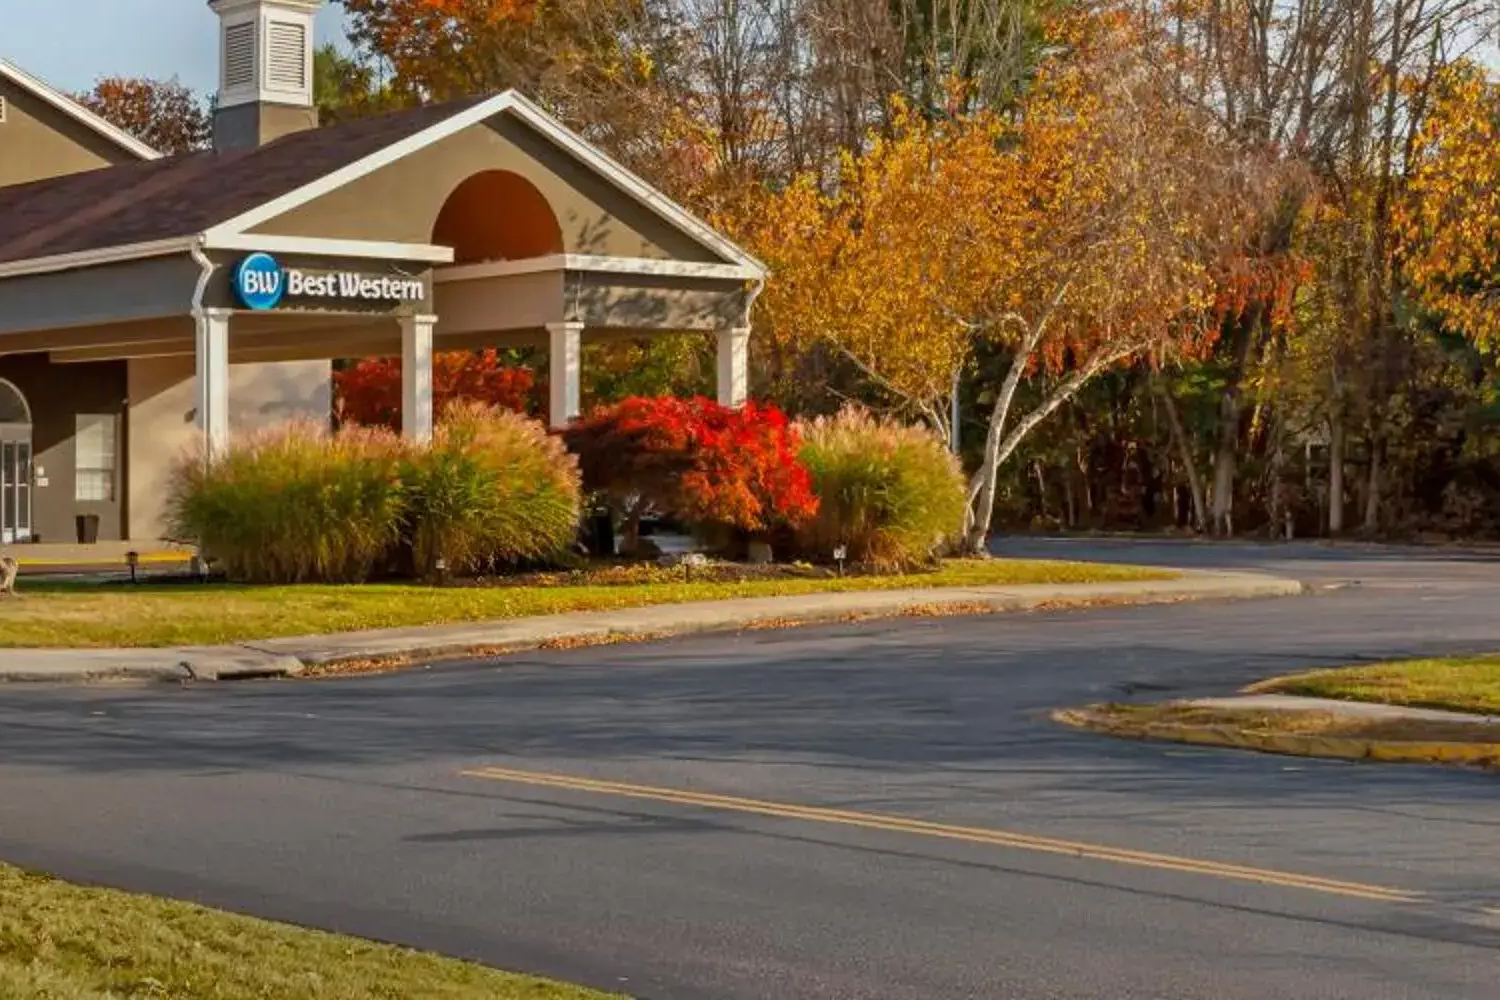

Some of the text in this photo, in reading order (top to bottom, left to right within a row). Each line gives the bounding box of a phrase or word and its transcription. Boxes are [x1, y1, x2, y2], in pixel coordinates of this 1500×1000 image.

[243, 270, 278, 294] BW
[288, 271, 423, 300] Best Western
